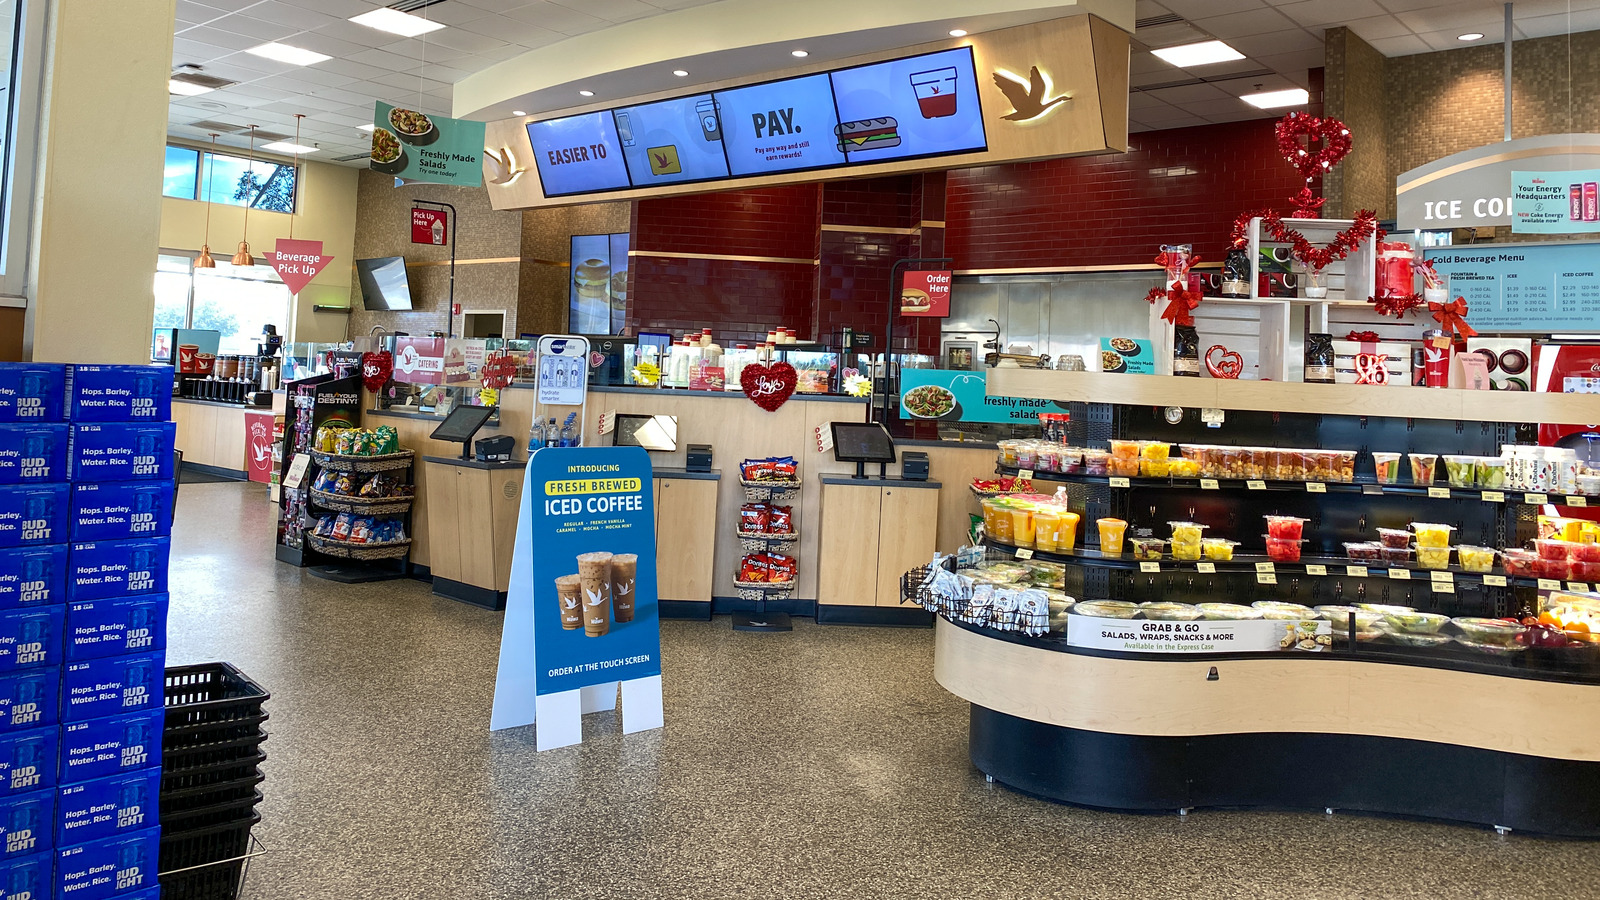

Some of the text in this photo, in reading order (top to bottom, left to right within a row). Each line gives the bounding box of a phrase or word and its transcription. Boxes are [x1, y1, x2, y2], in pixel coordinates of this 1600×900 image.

[752, 108, 801, 138] PAY.
[420, 149, 476, 163] Freshly Made
[548, 144, 607, 165] EASIER TO
[779, 151, 802, 159] rewards!
[419, 159, 446, 169] Salads
[1516, 193, 1565, 201] Headquarters
[1424, 200, 1462, 220] ICE
[426, 213, 434, 221] Up
[276, 251, 320, 264] Beverage
[1432, 254, 1525, 264] Cold Beverage Menu
[278, 264, 315, 276] Pick Up
[927, 274, 950, 283] Order
[930, 284, 948, 292] Here
[418, 360, 439, 369] CATERING
[751, 376, 785, 397] Love
[105, 388, 132, 396] Barley.
[132, 398, 153, 407] BUD
[984, 396, 1046, 408] freshly made
[130, 407, 157, 416] IGHT
[1010, 410, 1039, 419] salads
[568, 464, 620, 473] INTRODUCING
[550, 480, 637, 493] FRESH BREWED
[545, 495, 643, 516] ICED COFFEE
[748, 559, 768, 568] Doritos
[770, 564, 790, 572] Doritos
[1142, 623, 1200, 633] GRAB & GO
[1101, 631, 1137, 641] SALADS,
[1139, 633, 1171, 642] WRAPS,
[1124, 642, 1155, 650] Available
[548, 654, 650, 677] ORDER AT THE TOUCH SCREEN
[66, 803, 117, 819] Hops. Barley.
[117, 806, 140, 818] BUD
[65, 815, 112, 829] Water. Rice.
[117, 813, 145, 828] IGHT
